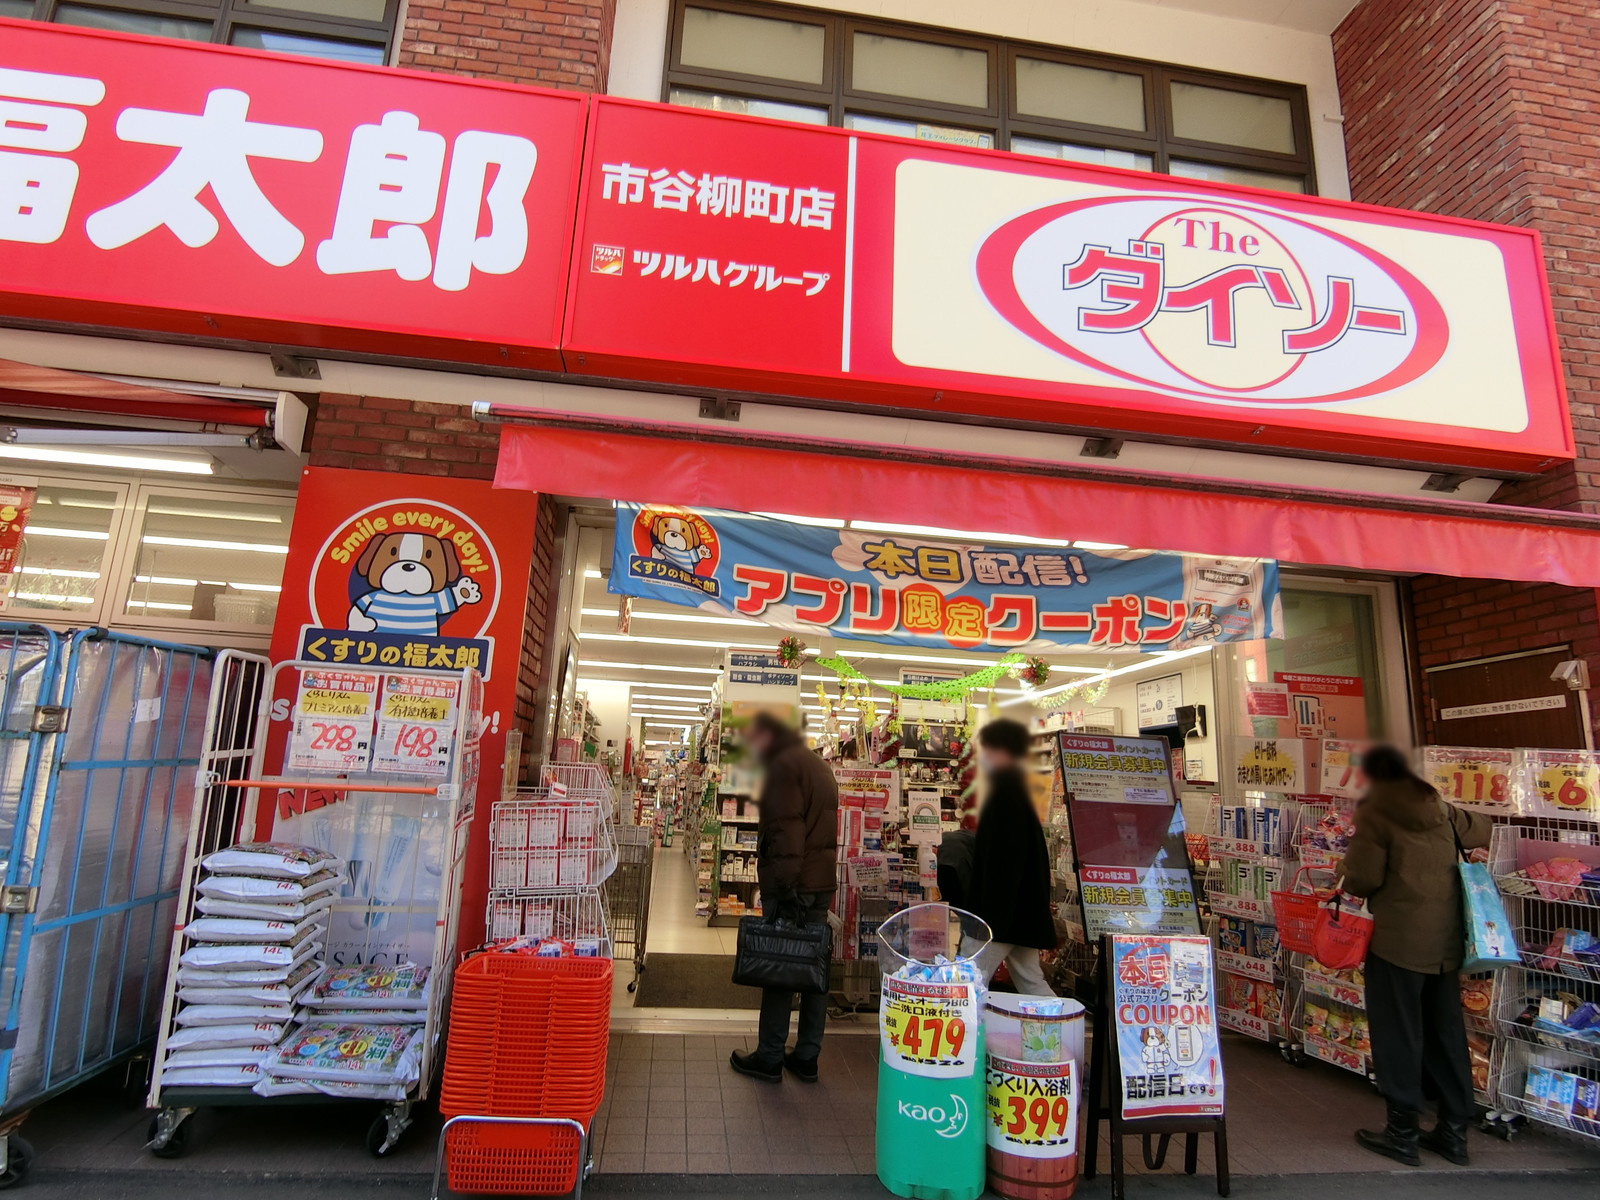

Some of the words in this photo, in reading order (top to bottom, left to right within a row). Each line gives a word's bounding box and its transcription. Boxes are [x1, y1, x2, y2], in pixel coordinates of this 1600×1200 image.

[602, 163, 835, 231] 市谷柳町店
[1174, 217, 1261, 257] The
[595, 247, 622, 257] ツルハ
[632, 249, 831, 297] ツルハグループ
[1062, 239, 1407, 355] ダイソー
[331, 516, 389, 565] Smile
[392, 511, 455, 538] every
[452, 530, 490, 574] day!
[862, 538, 1090, 588] 本日配信!
[630, 560, 716, 593] くすりの福太郎
[732, 563, 1188, 645] アプリ限定クーポン
[306, 635, 481, 670] くすりの福太郎
[1066, 739, 1110, 750] くすりの福太郎
[1064, 752, 1167, 776] 新規会員募集中
[1236, 842, 1255, 853] 888
[276, 882, 295, 890] 14L
[1086, 872, 1132, 882] くすりの福太郎
[1238, 900, 1258, 912] 888
[266, 920, 286, 929] 14L
[263, 946, 283, 954] 14L
[1119, 953, 1169, 987] 本日
[1245, 961, 1266, 973] 648
[1159, 988, 1209, 1003] クーポン
[885, 1001, 962, 1018] ミニ洗口液付き
[1118, 1004, 1210, 1025] COUPON
[253, 1023, 273, 1031] 14L
[1241, 1017, 1262, 1031] 648
[890, 1016, 966, 1058] ¥479
[251, 1044, 271, 1052] 14L
[240, 1064, 261, 1074] 14L
[985, 1069, 1071, 1097] てづくり入浴剤
[898, 1099, 946, 1123] kao
[993, 1097, 1069, 1137] ¥399
